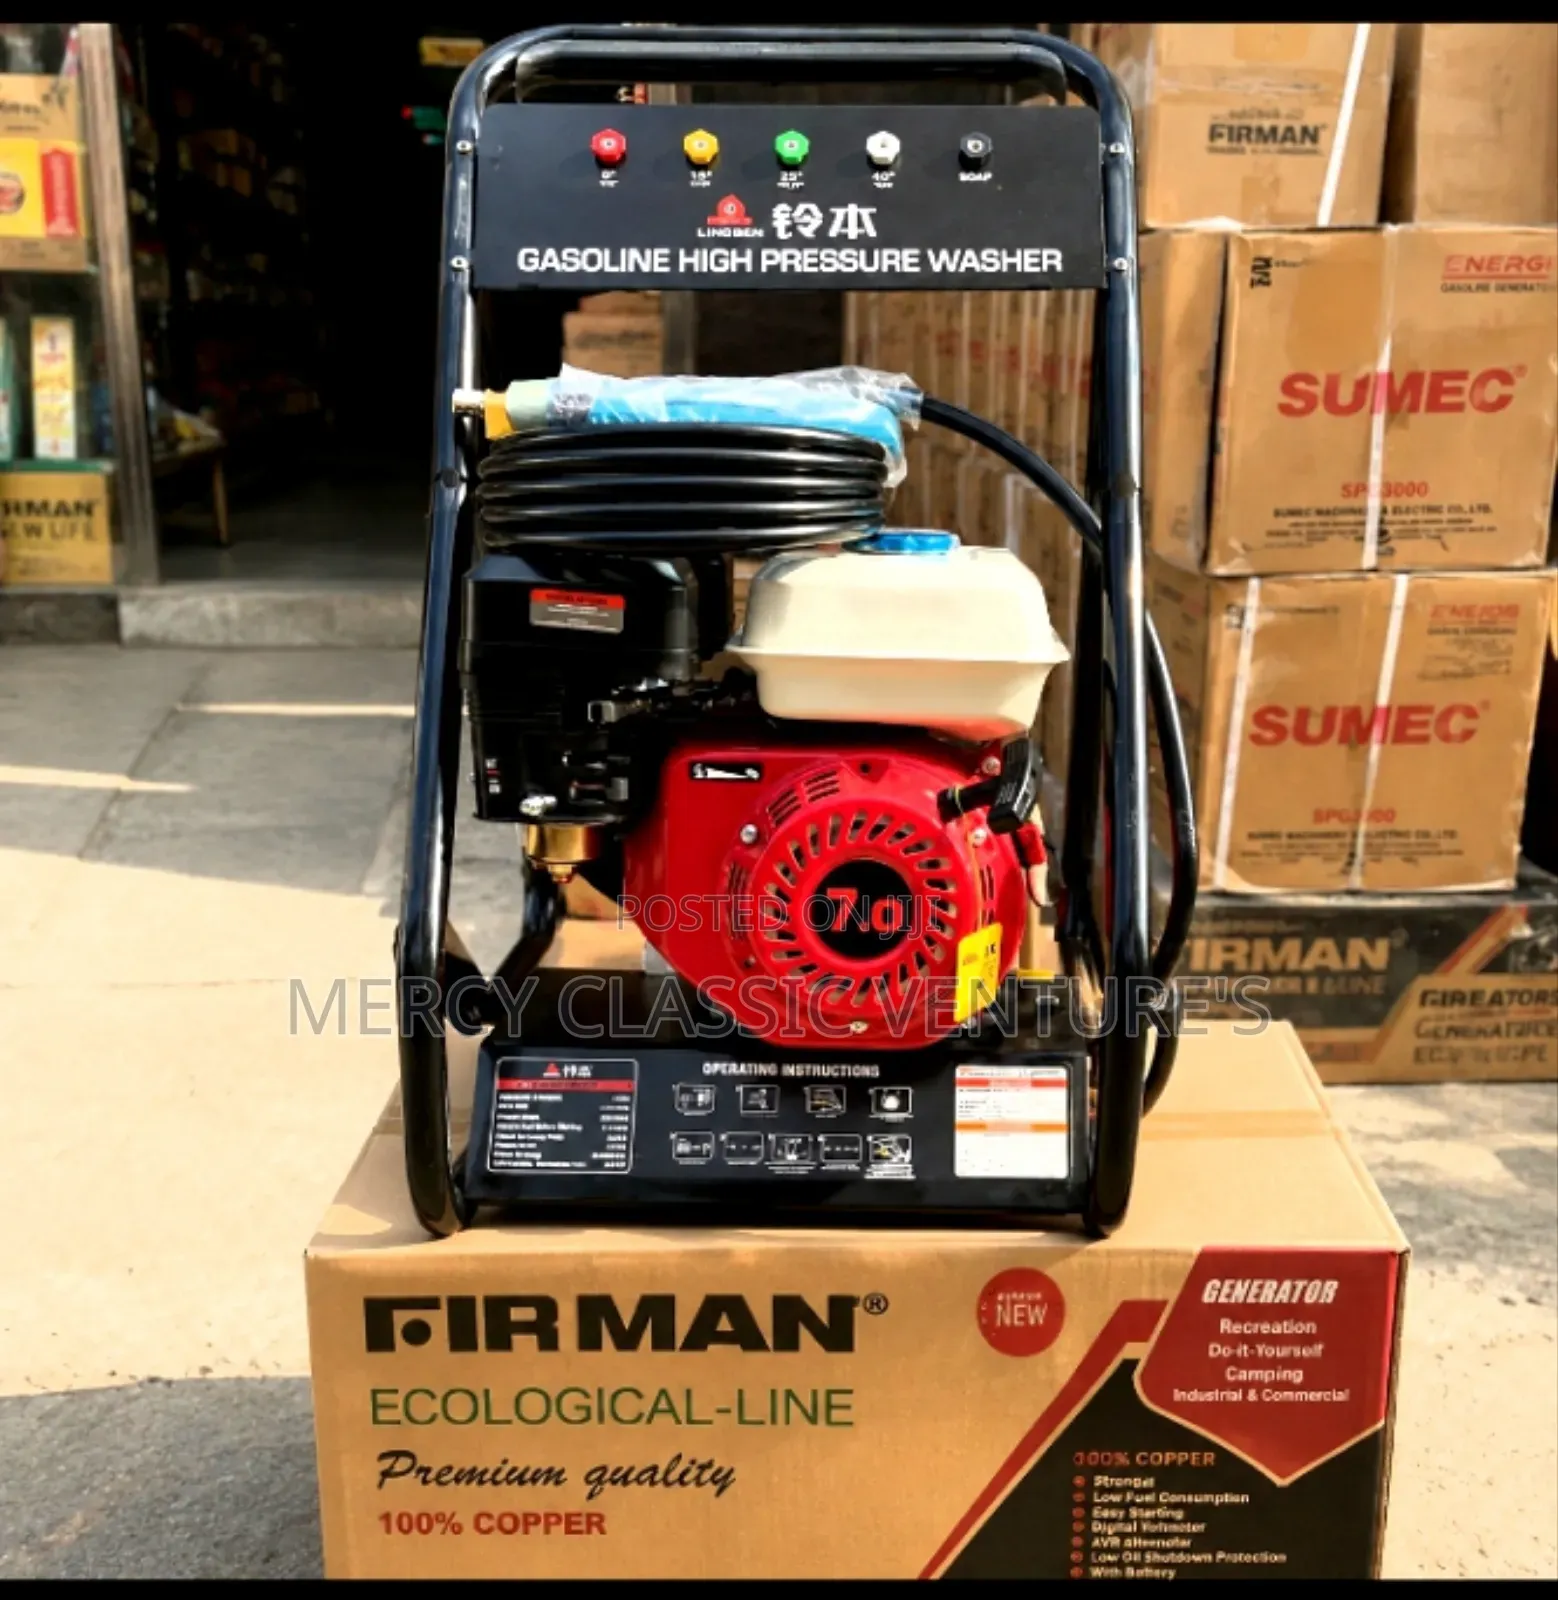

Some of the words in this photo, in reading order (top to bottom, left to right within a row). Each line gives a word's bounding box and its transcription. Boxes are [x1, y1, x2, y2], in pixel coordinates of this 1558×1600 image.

[958, 171, 993, 182] SOAP
[517, 248, 671, 273] GASOLINE
[678, 248, 752, 273] HIGH
[760, 248, 921, 273] PRESSURE
[927, 248, 1063, 273] WASHER
[1341, 481, 1430, 499] SP3000
[1186, 936, 1390, 972] IRMAN
[702, 1062, 778, 1078] OPERATING
[781, 1063, 880, 1079] INSTRUCTIONS
[1201, 1278, 1339, 1304] GENERATOR
[996, 1302, 1048, 1328] NEW
[1219, 1318, 1317, 1335] Recreation
[1208, 1342, 1324, 1359] Do-it-Yourself
[1225, 1365, 1304, 1384] Camping
[1172, 1388, 1243, 1403] Industrial
[1246, 1388, 1258, 1403] &
[1261, 1388, 1350, 1403] Commercial
[369, 1387, 855, 1427] ECOLOGICAL-LINE
[1135, 1452, 1216, 1466] COPPER
[376, 1449, 568, 1491] Premium
[583, 1452, 736, 1501] quality
[1093, 1492, 1123, 1504] Low
[1126, 1492, 1155, 1504] Fuel
[1158, 1491, 1250, 1507] Consumption
[1091, 1507, 1125, 1520] Easy
[1128, 1506, 1185, 1520] Starting
[378, 1511, 462, 1536] 100%
[472, 1511, 607, 1536] COPPER
[1091, 1520, 1138, 1535] Digital
[1091, 1537, 1121, 1549] AVR
[1091, 1552, 1119, 1564] Low
[1121, 1552, 1142, 1564] Oil
[1144, 1551, 1213, 1565] Shutdown
[1215, 1551, 1288, 1565] Protection
[1089, 1567, 1122, 1579] With
[1124, 1567, 1177, 1580] Battery
